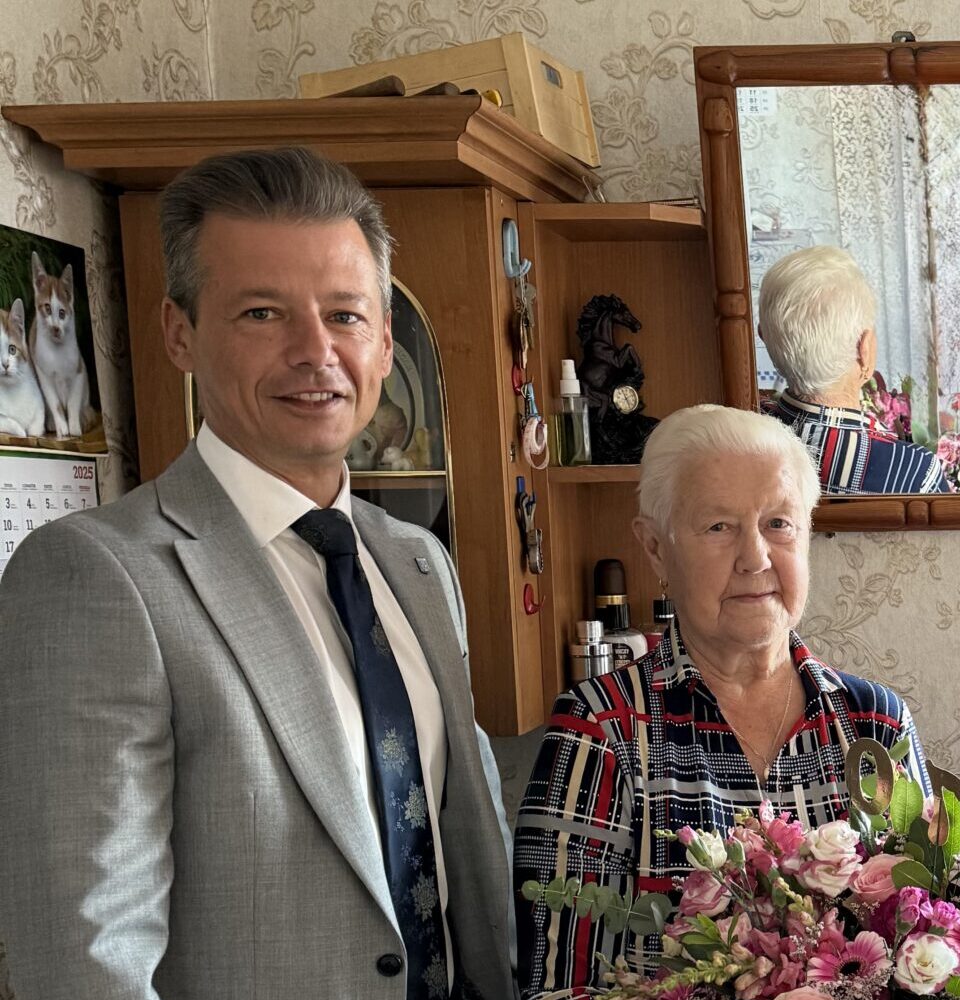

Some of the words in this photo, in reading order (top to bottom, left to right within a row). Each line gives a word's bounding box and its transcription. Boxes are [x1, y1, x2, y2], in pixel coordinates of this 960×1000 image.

[73, 466, 93, 479] 2025
[5, 497, 11, 509] 3
[26, 498, 32, 509] 4
[45, 498, 50, 509] 5
[64, 498, 69, 509] 6
[81, 498, 86, 509] 7
[3, 519, 12, 531] 10
[26, 519, 33, 531] 11
[5, 541, 14, 553] 17
